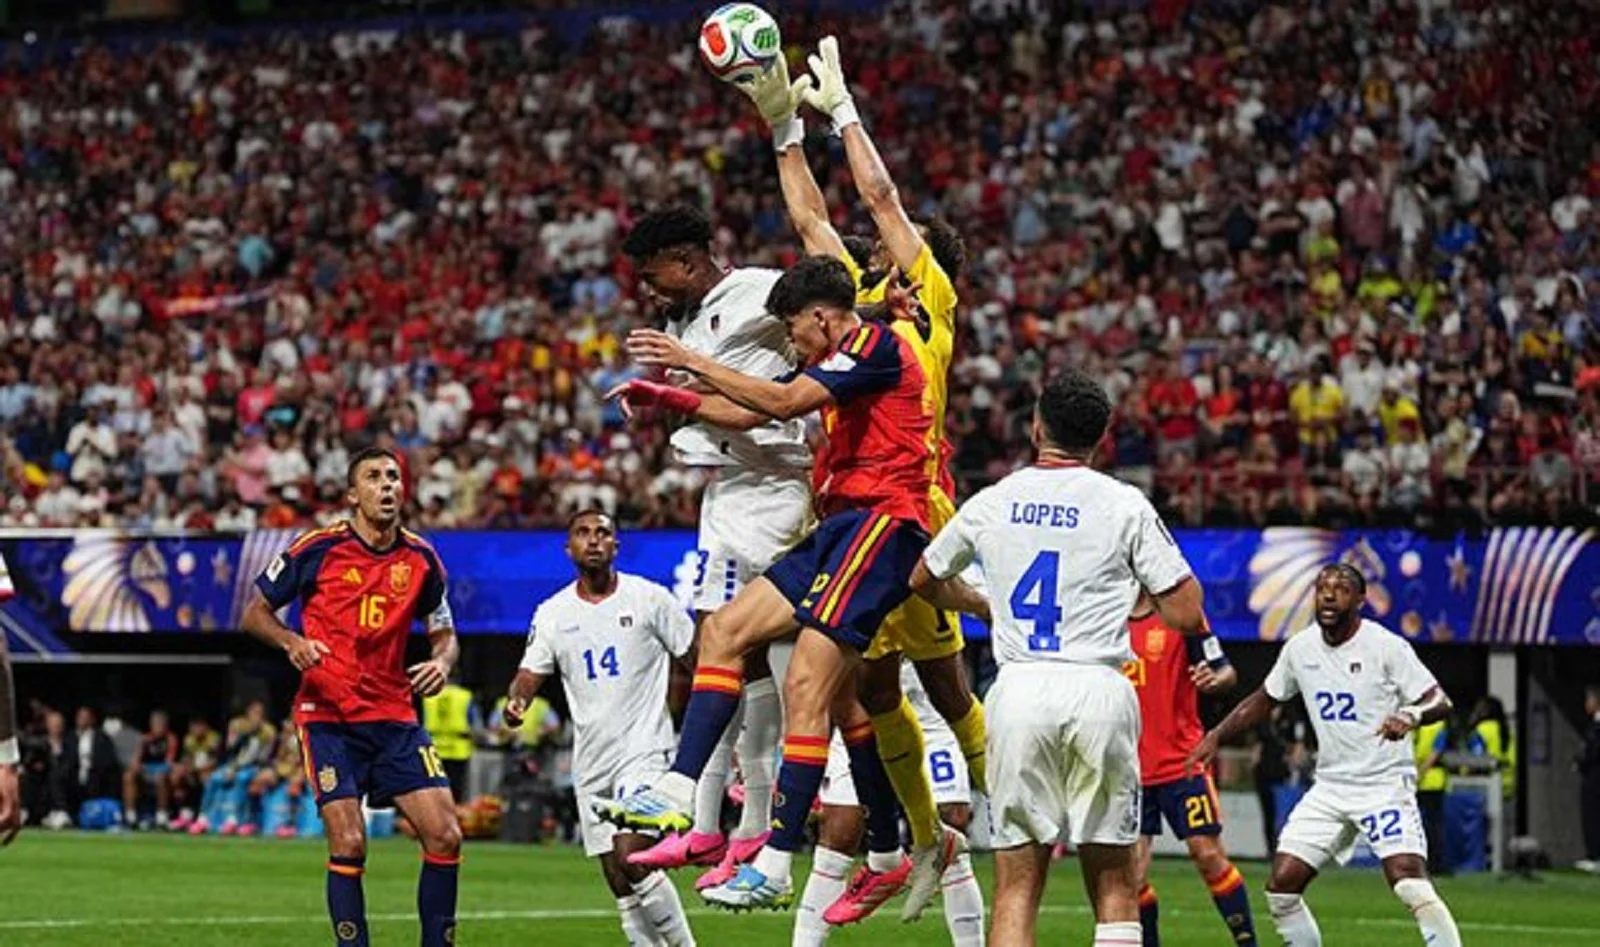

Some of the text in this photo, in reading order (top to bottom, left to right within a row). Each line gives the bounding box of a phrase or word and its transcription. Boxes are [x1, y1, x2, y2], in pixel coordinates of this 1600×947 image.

[1011, 502, 1080, 528] LOPES
[358, 596, 387, 629] 16
[1010, 550, 1063, 652] 4
[583, 646, 620, 680] 14
[1122, 657, 1147, 687] 21
[1315, 691, 1358, 721] 22
[929, 750, 956, 783] 6
[1185, 795, 1213, 828] 21
[1361, 809, 1402, 843] 22
